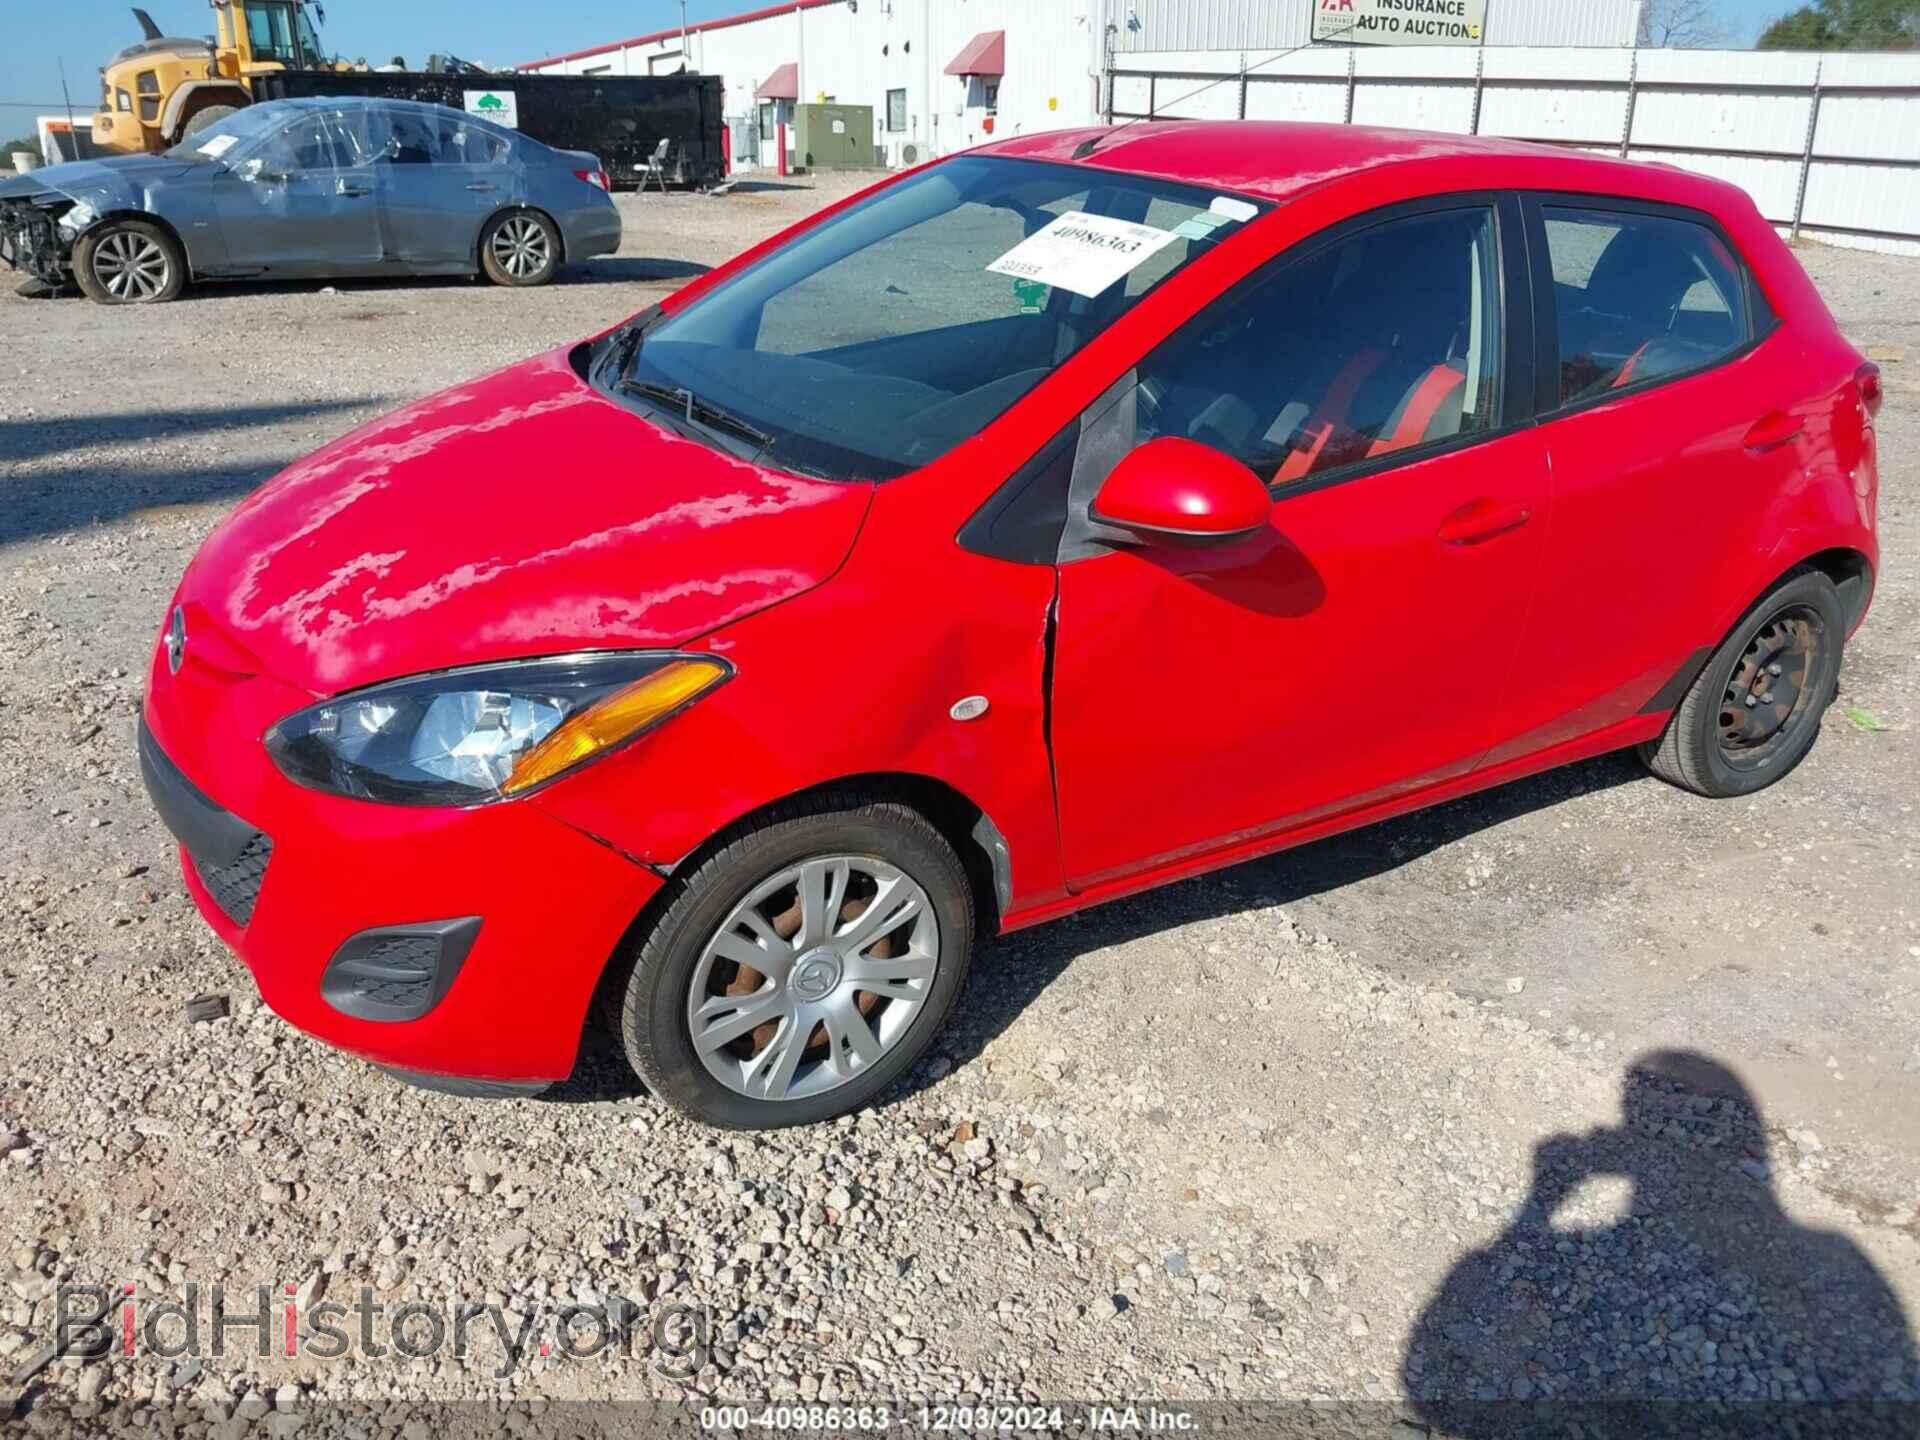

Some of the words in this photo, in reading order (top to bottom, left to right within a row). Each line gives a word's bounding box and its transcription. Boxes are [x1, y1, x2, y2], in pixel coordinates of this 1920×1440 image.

[1377, 0, 1464, 16] INSURANCE
[1357, 14, 1399, 32] AUTO
[1404, 19, 1479, 39] AUCTIONS
[1052, 226, 1141, 254] 40986363
